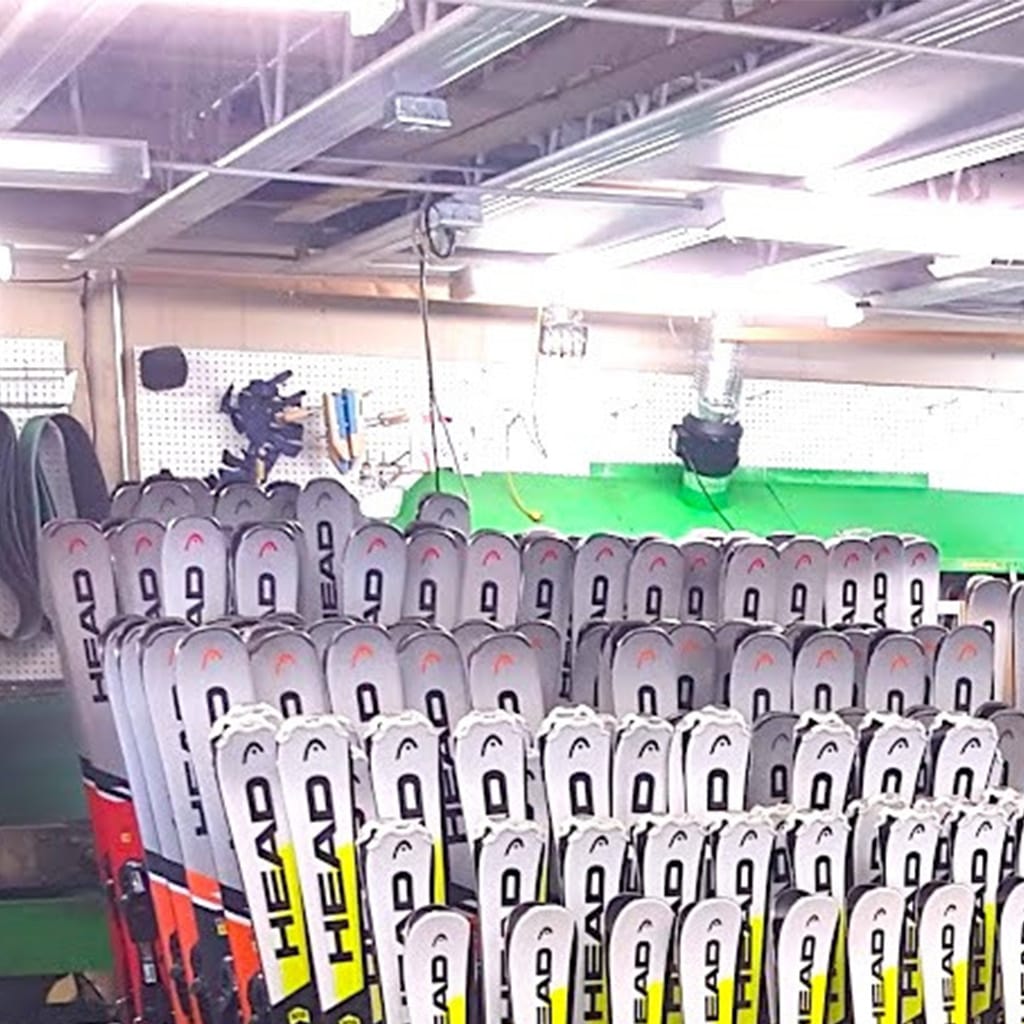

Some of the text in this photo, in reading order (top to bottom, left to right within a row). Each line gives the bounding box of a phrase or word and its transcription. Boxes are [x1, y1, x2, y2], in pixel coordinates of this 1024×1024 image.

[186, 566, 204, 627] AD
[316, 520, 338, 618] EAD
[364, 568, 383, 623] AD
[874, 573, 887, 627] AD
[911, 579, 924, 626] AD
[246, 776, 299, 959] HEAD
[305, 774, 354, 964] HEAD
[584, 865, 605, 1021] HEAD
